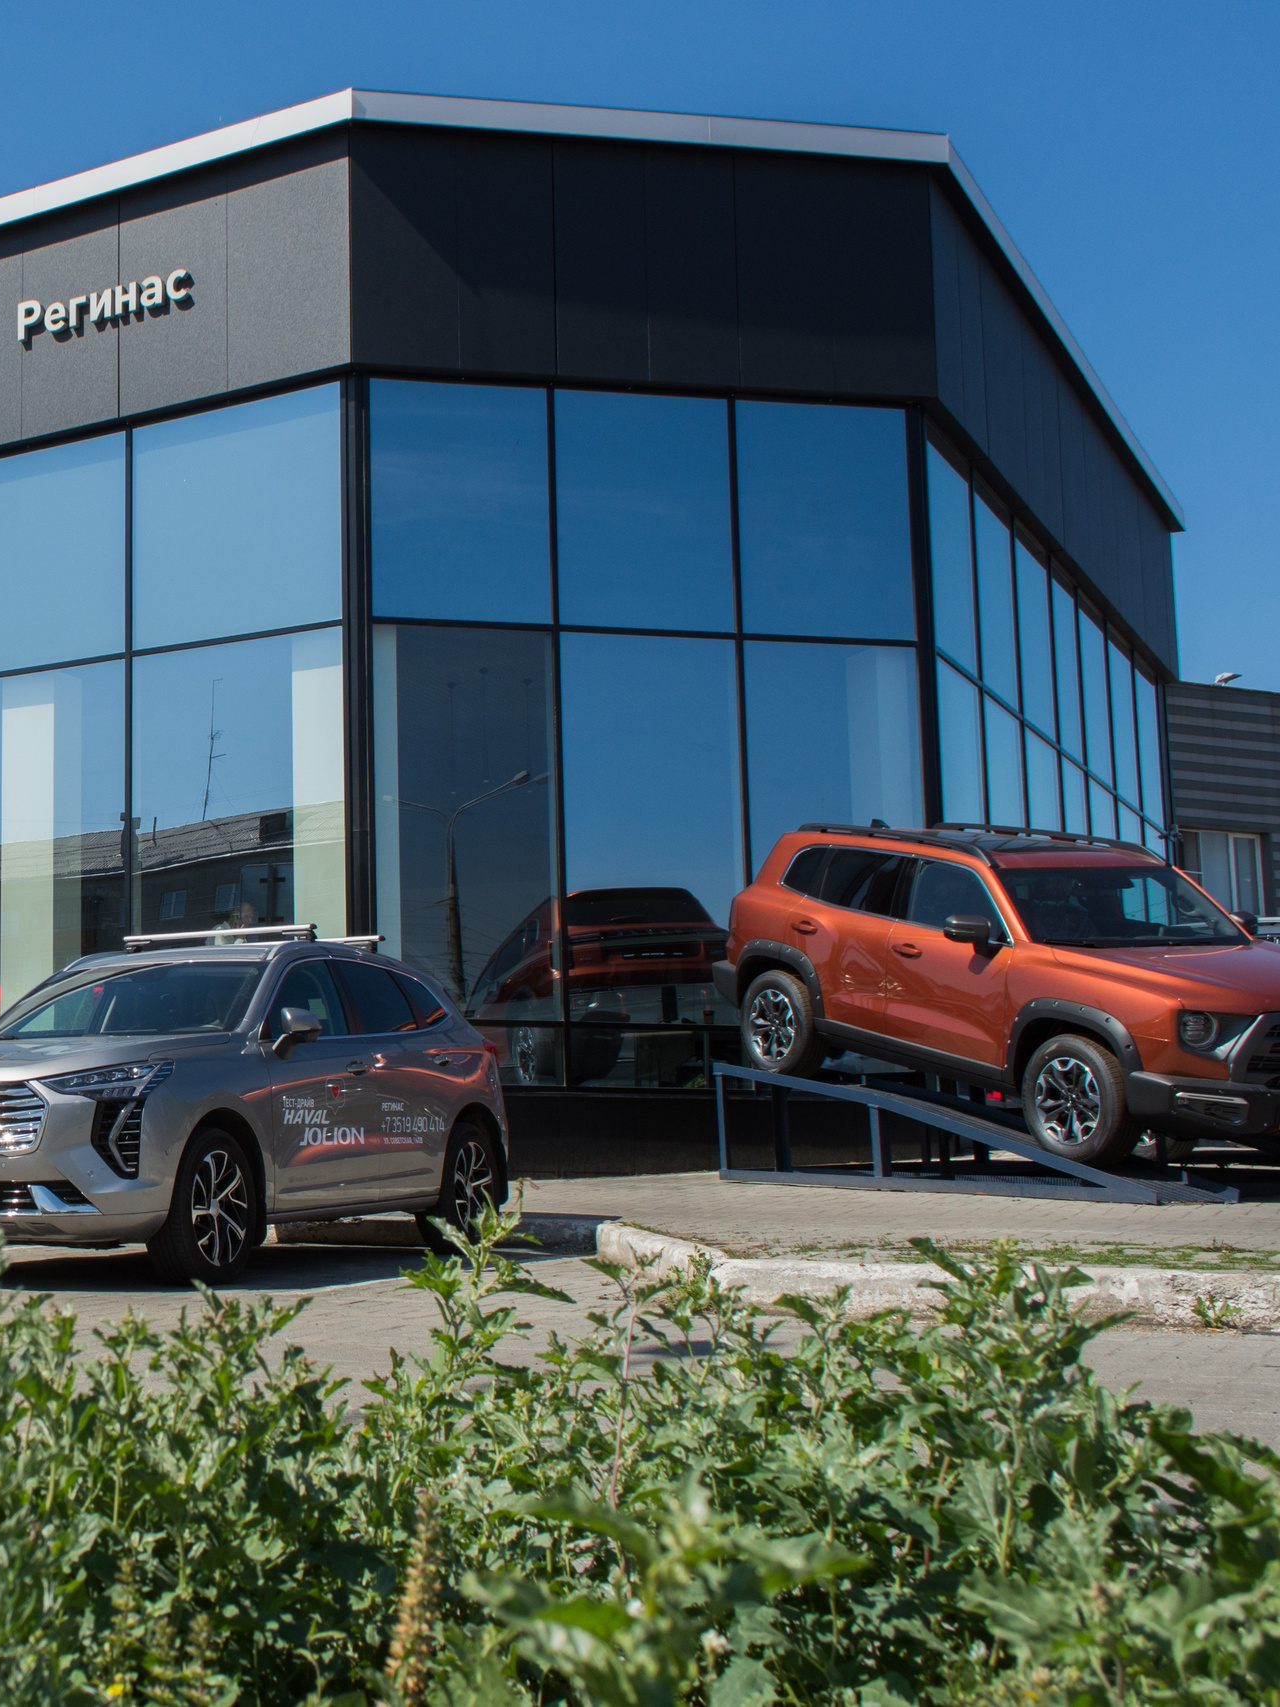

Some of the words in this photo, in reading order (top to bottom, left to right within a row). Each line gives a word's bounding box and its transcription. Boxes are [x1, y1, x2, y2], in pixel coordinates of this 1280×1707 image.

[17, 268, 190, 342] Регинас
[282, 1097, 315, 1108] ТЕСТ-ДРАЙВ
[381, 1102, 404, 1111] РЕГИНАС
[283, 1109, 330, 1125] HAVAL
[392, 1116, 411, 1133] 3519
[412, 1116, 428, 1133] 490
[429, 1116, 445, 1132] 414
[299, 1127, 365, 1146] JOLION
